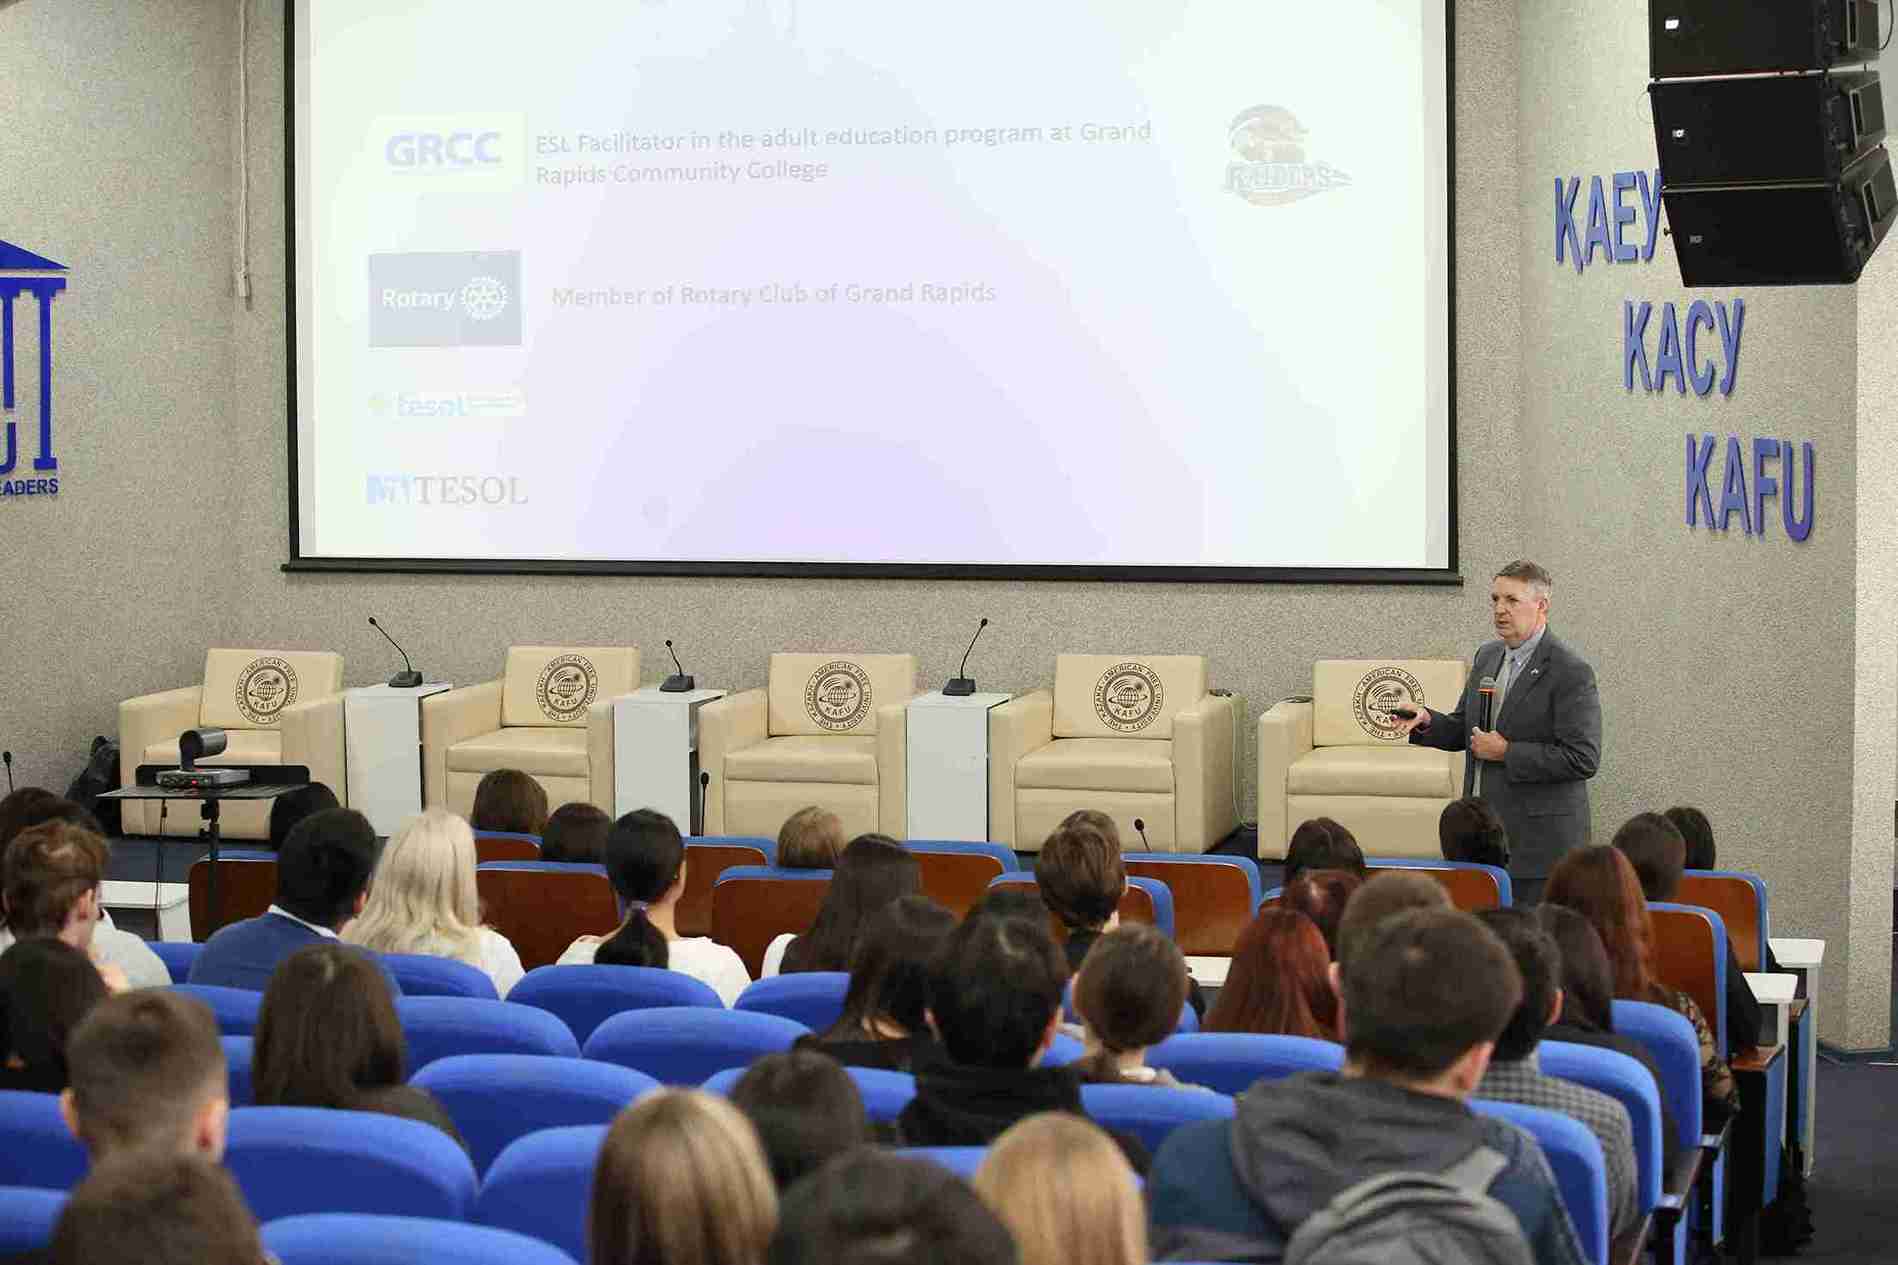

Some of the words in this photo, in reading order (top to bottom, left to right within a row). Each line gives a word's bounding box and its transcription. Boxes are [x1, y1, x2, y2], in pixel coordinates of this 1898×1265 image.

[385, 131, 503, 167] GRCC
[536, 135, 571, 154] ESL
[578, 130, 682, 153] Facilitator
[691, 129, 711, 150] in
[719, 128, 753, 149] the
[761, 127, 817, 148] adult
[825, 122, 936, 145] education
[944, 125, 1043, 151] program
[1048, 122, 1072, 142] at
[1080, 120, 1151, 142] Grand
[536, 161, 608, 190] Rapids
[614, 162, 740, 186] Community
[747, 160, 828, 183] College
[383, 286, 456, 312] Rotary
[552, 284, 645, 305] Member
[652, 283, 672, 304] of
[681, 284, 752, 309] Rotary
[760, 281, 808, 304] Club
[816, 281, 840, 303] of
[847, 281, 913, 304] Grand
[920, 280, 996, 310] Rapids
[392, 391, 466, 416] tesol
[0, 478, 58, 496] ADERS
[1686, 432, 1815, 543] KAFU
[825, 705, 851, 717] KAFU
[1114, 707, 1142, 718] KAFU
